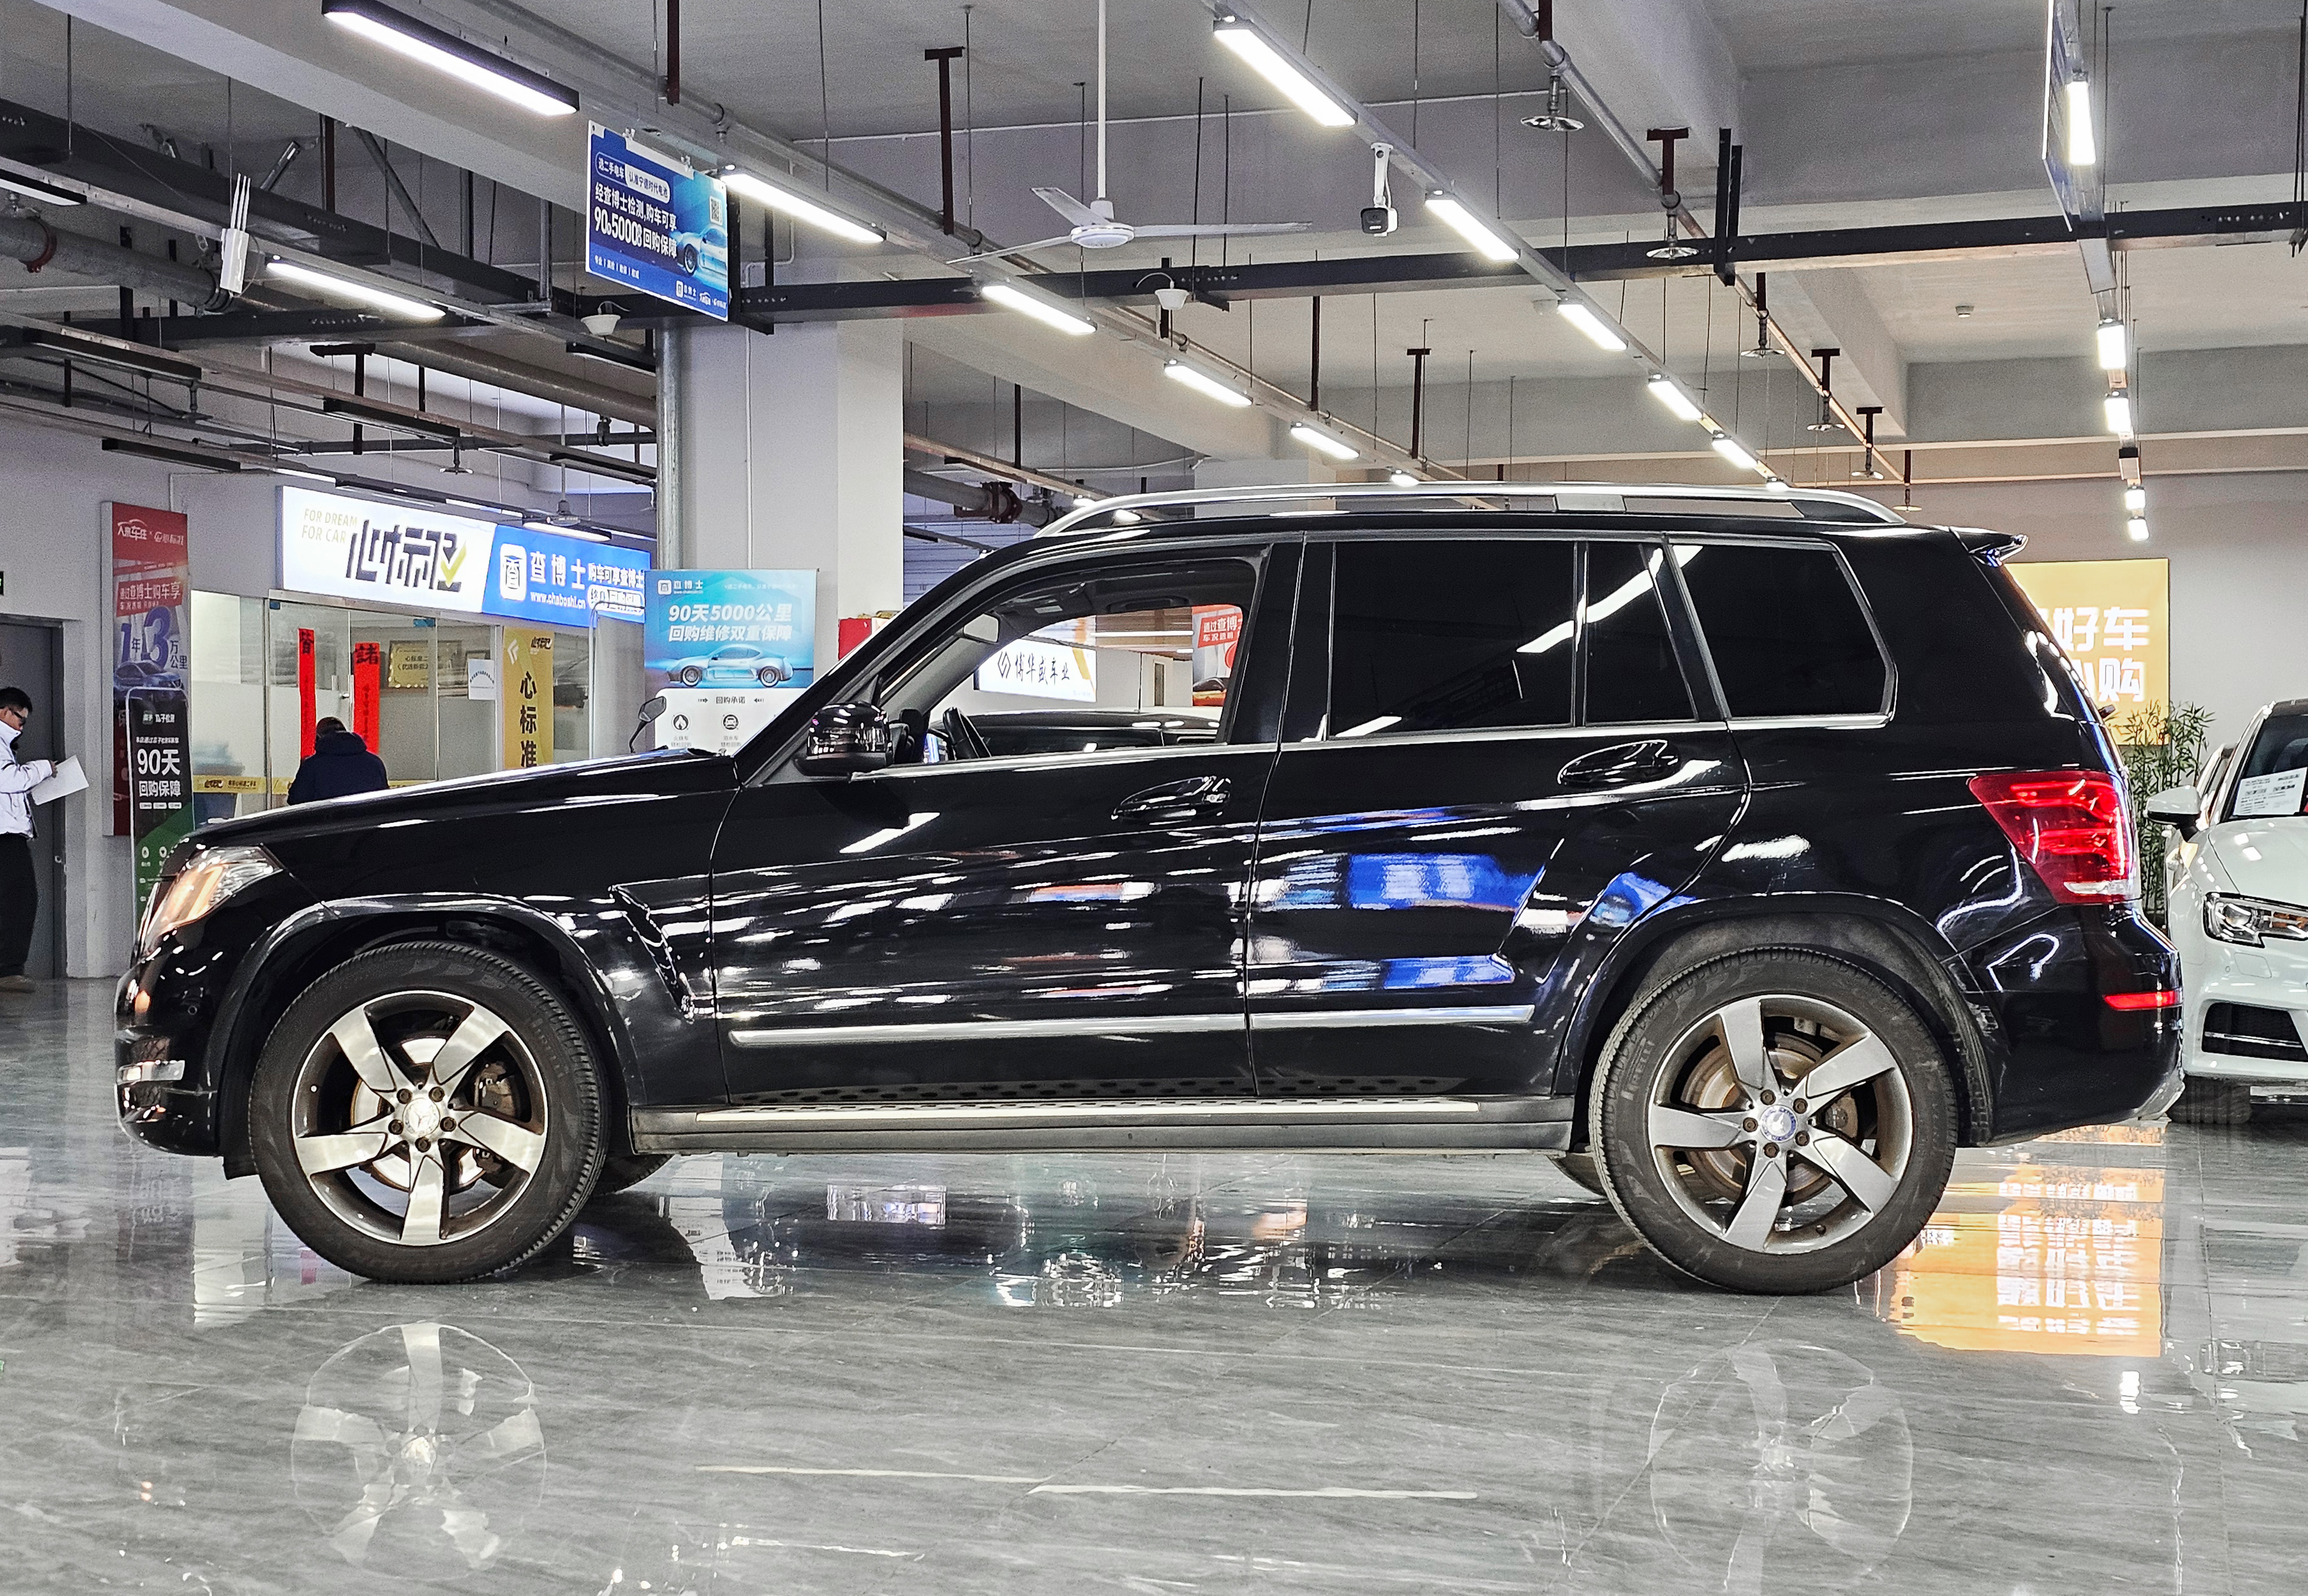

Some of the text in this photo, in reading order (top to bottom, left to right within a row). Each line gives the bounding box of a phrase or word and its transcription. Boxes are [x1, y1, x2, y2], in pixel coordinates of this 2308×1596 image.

[304, 508, 358, 527] FOR DREAM
[301, 524, 347, 545] FOR CAR
[530, 550, 587, 590] 查博士
[668, 603, 793, 623] 90天5000公里
[668, 625, 793, 642] 回购维修双重保障
[137, 748, 180, 776] 90天
[139, 780, 181, 797] 回购保障
